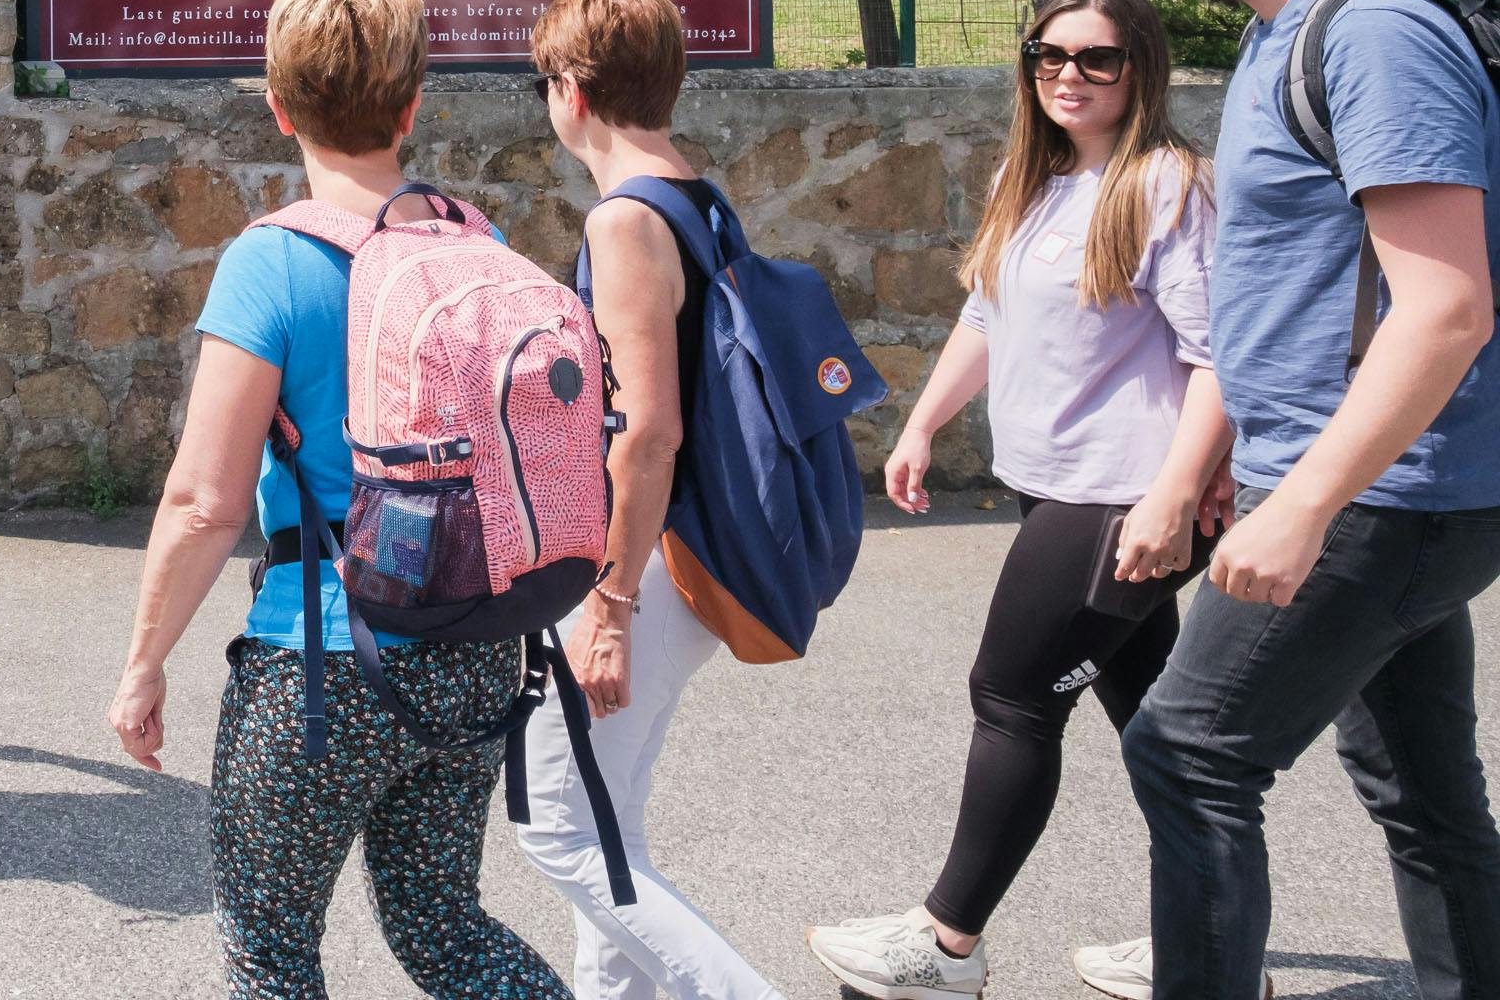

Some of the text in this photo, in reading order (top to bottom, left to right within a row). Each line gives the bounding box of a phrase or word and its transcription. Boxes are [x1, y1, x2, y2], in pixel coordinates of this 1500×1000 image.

[122, 6, 164, 21] Last
[172, 5, 235, 25] guided
[243, 8, 270, 19] tou
[423, 7, 458, 17] utes
[467, 3, 523, 17] before
[68, 32, 113, 47] Mail:
[120, 31, 265, 46] info@domitilla.in
